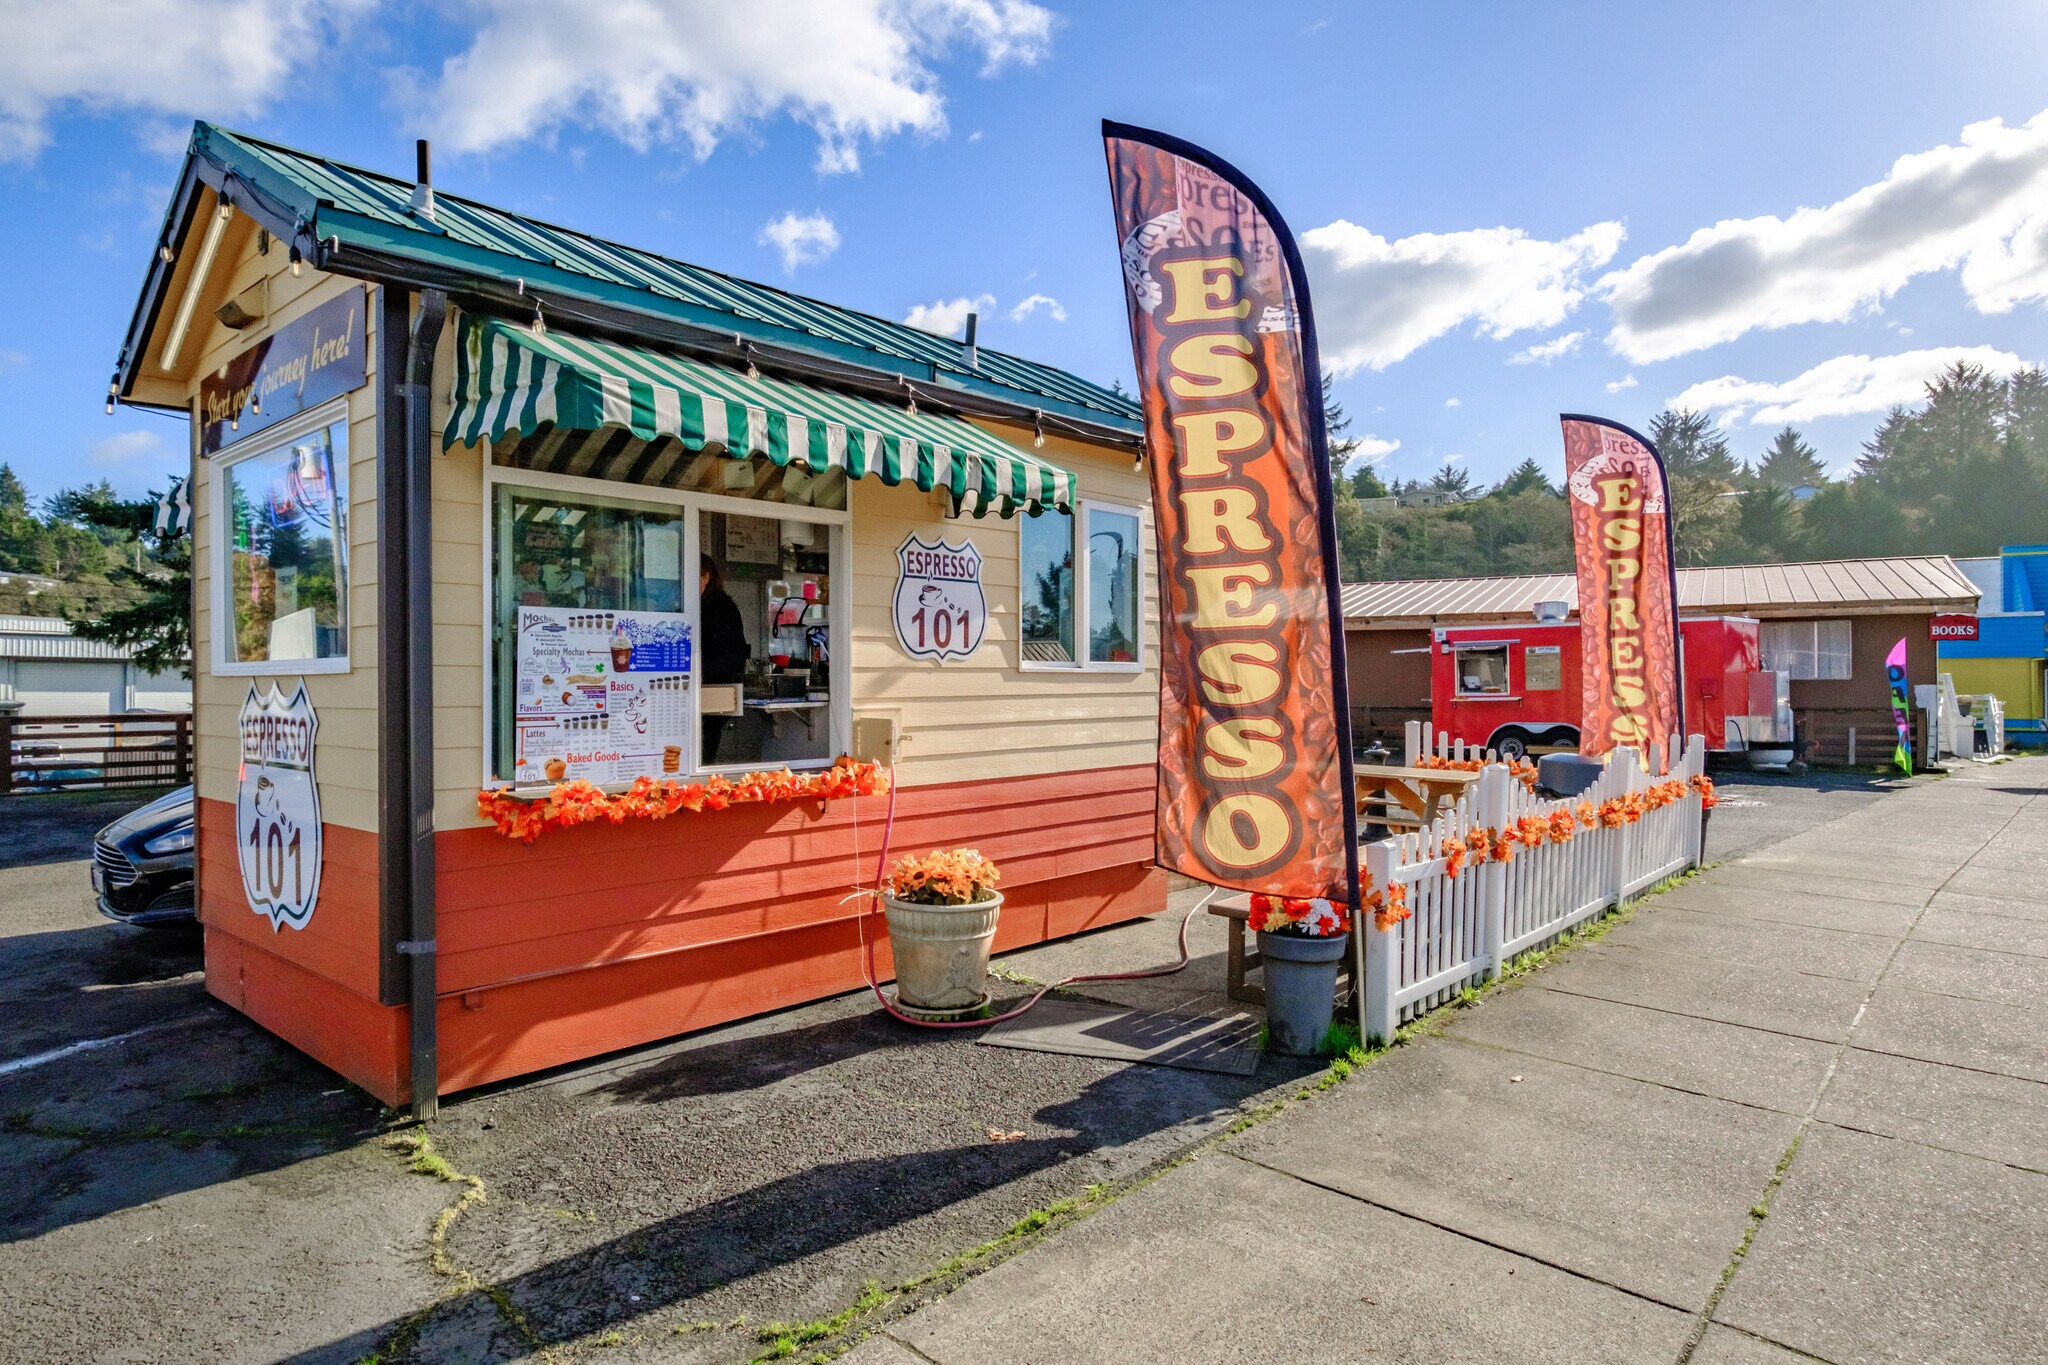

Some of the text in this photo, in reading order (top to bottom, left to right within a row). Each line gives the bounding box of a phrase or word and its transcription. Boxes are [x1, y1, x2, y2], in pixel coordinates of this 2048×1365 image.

[204, 389, 231, 429] Start
[257, 354, 308, 417] journey
[311, 308, 355, 372] here!
[907, 551, 976, 578] ESPRESSO
[1161, 256, 1293, 868] ESPRESSO
[912, 607, 969, 648] 101
[1931, 625, 1975, 635] BOOKS
[533, 647, 585, 657] Specialty Mochas
[610, 681, 634, 691] Basics
[520, 704, 543, 712] Flavors
[246, 714, 307, 763] ESPRESSO
[526, 729, 546, 738] Lattes
[567, 750, 620, 763] Baked Goods
[250, 818, 302, 906] 101
